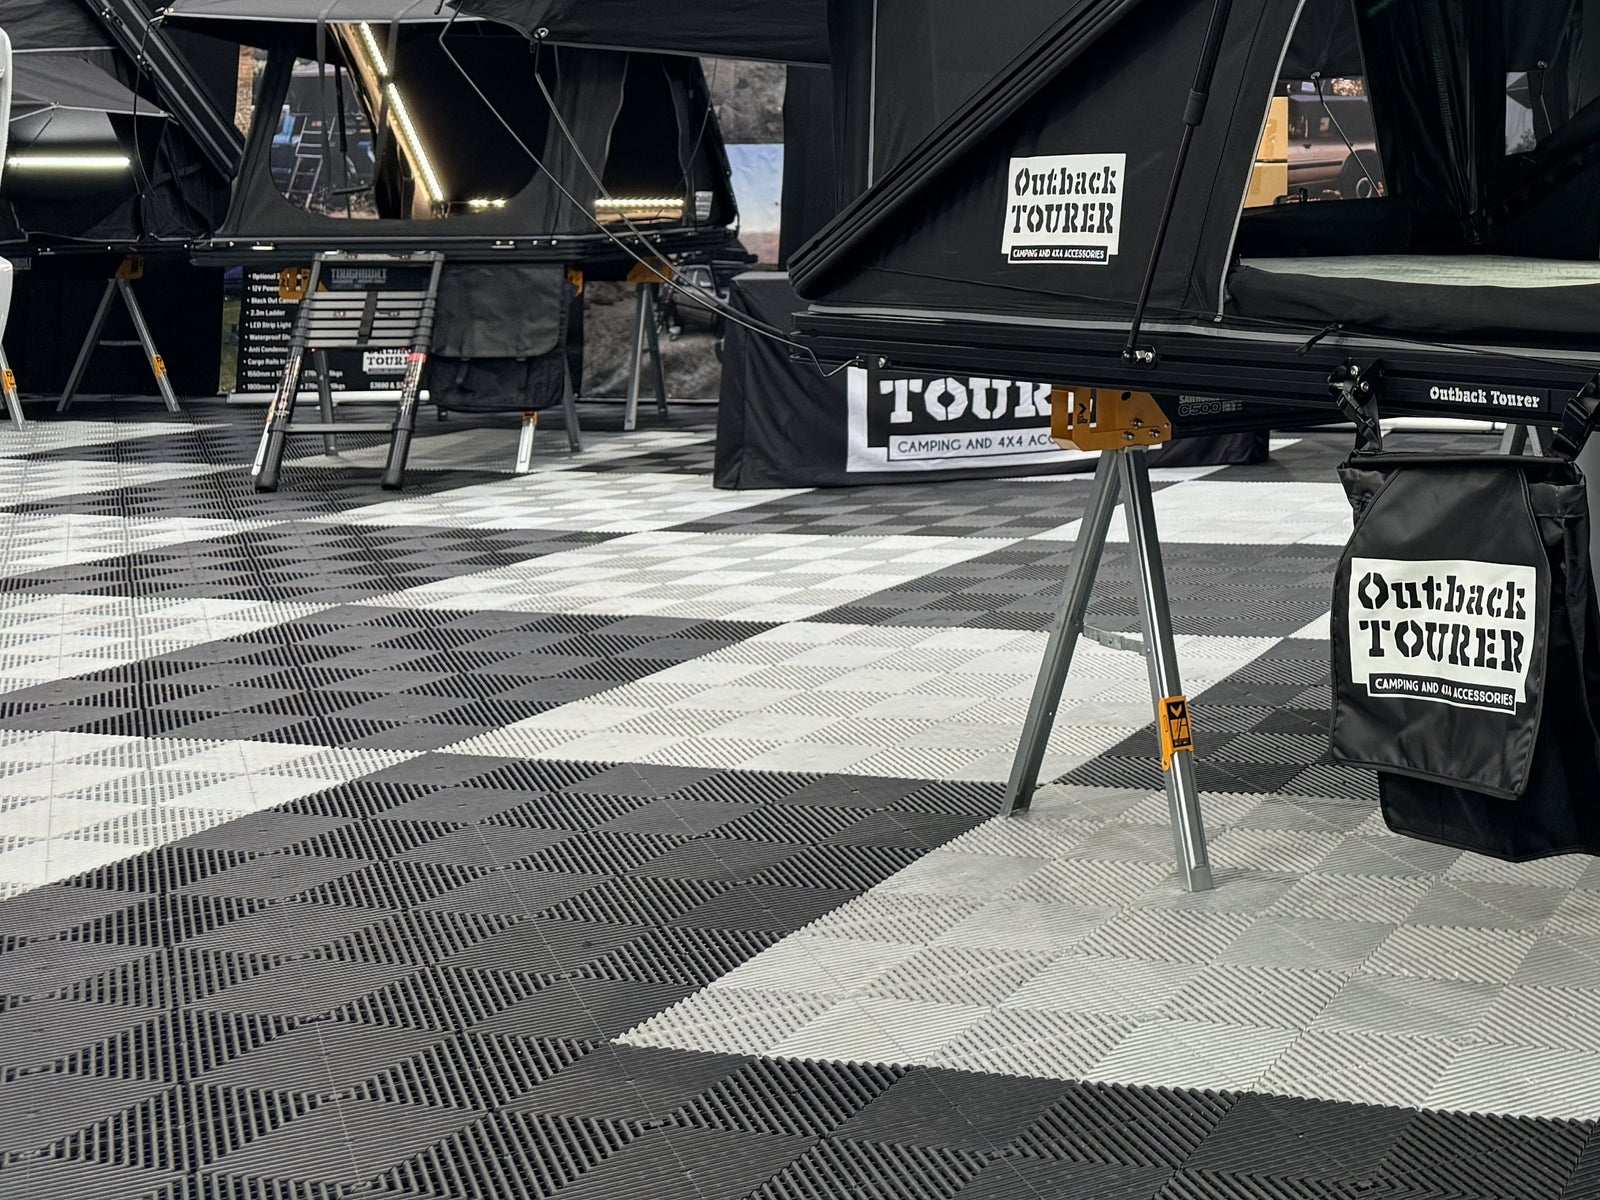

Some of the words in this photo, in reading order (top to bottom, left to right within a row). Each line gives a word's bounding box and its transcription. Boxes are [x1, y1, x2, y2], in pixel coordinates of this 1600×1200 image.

[1015, 166, 1117, 196] Outback
[1012, 202, 1114, 233] TOURER
[1013, 249, 1038, 258] CAMPING
[1039, 249, 1051, 258] AND
[1064, 249, 1105, 259] ACCESSORIES
[880, 377, 1052, 424] TOUR
[1429, 386, 1488, 404] Outback
[1490, 390, 1540, 408] Tourer
[897, 439, 962, 453] CAMPING
[966, 437, 993, 450] AND
[999, 435, 1023, 448] 4X4
[1357, 572, 1526, 620] Outback
[1359, 620, 1524, 673] TOURER
[1375, 678, 1419, 692] CAMPING
[1421, 681, 1439, 694] AND
[1440, 684, 1452, 697] 4X4
[1452, 686, 1514, 707] ACCESSORIES
